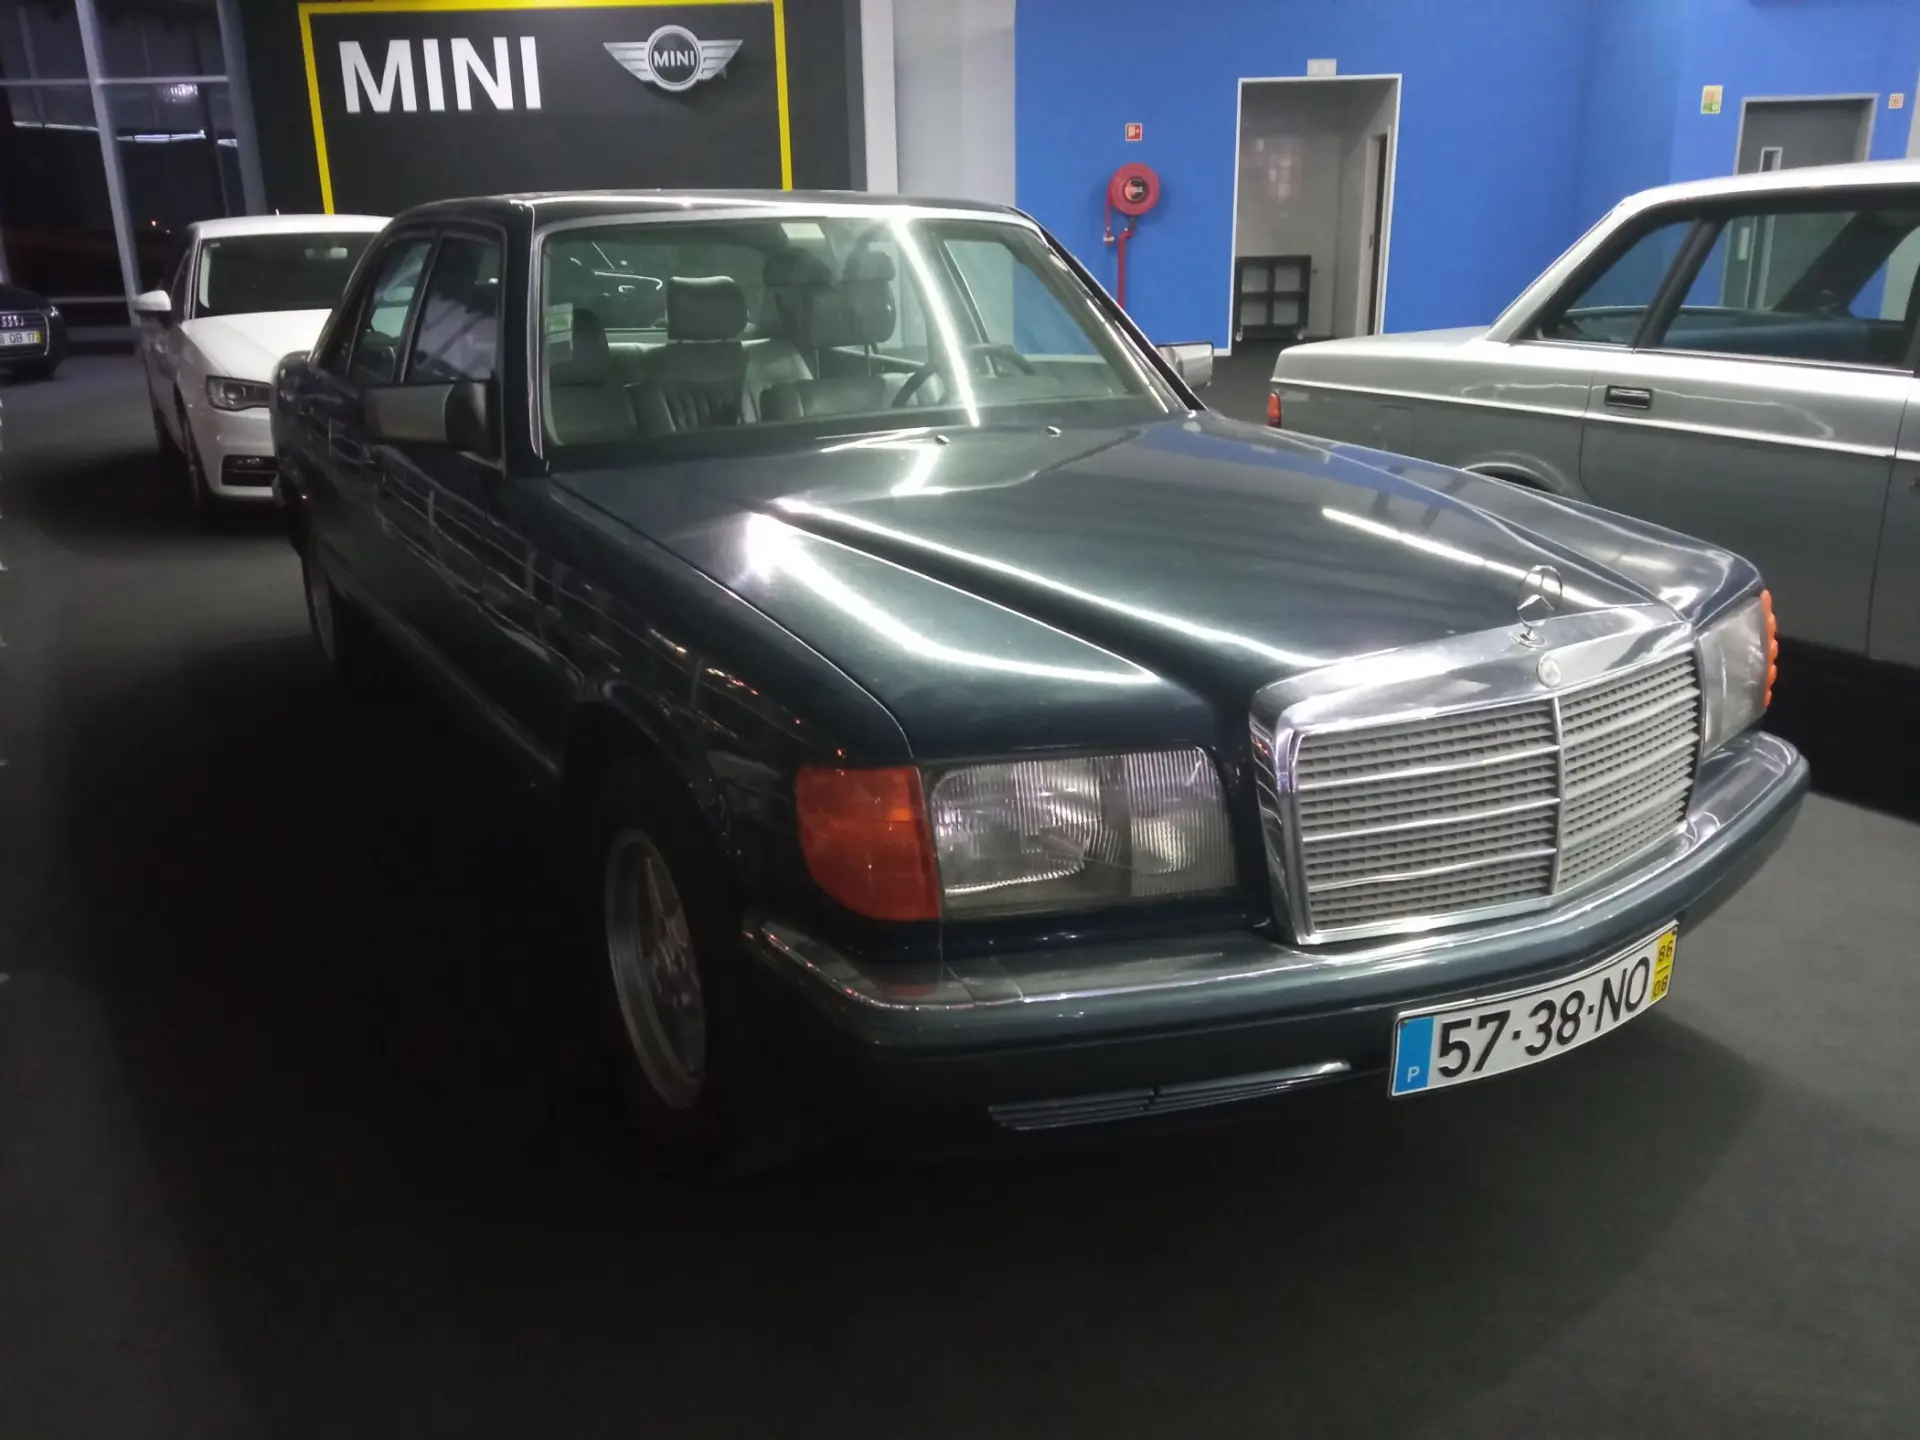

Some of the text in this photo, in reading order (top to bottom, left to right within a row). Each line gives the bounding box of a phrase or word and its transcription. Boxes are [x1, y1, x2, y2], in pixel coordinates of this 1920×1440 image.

[653, 50, 695, 67] MINI
[339, 36, 542, 113] MINI
[1406, 1066, 1420, 1083] P
